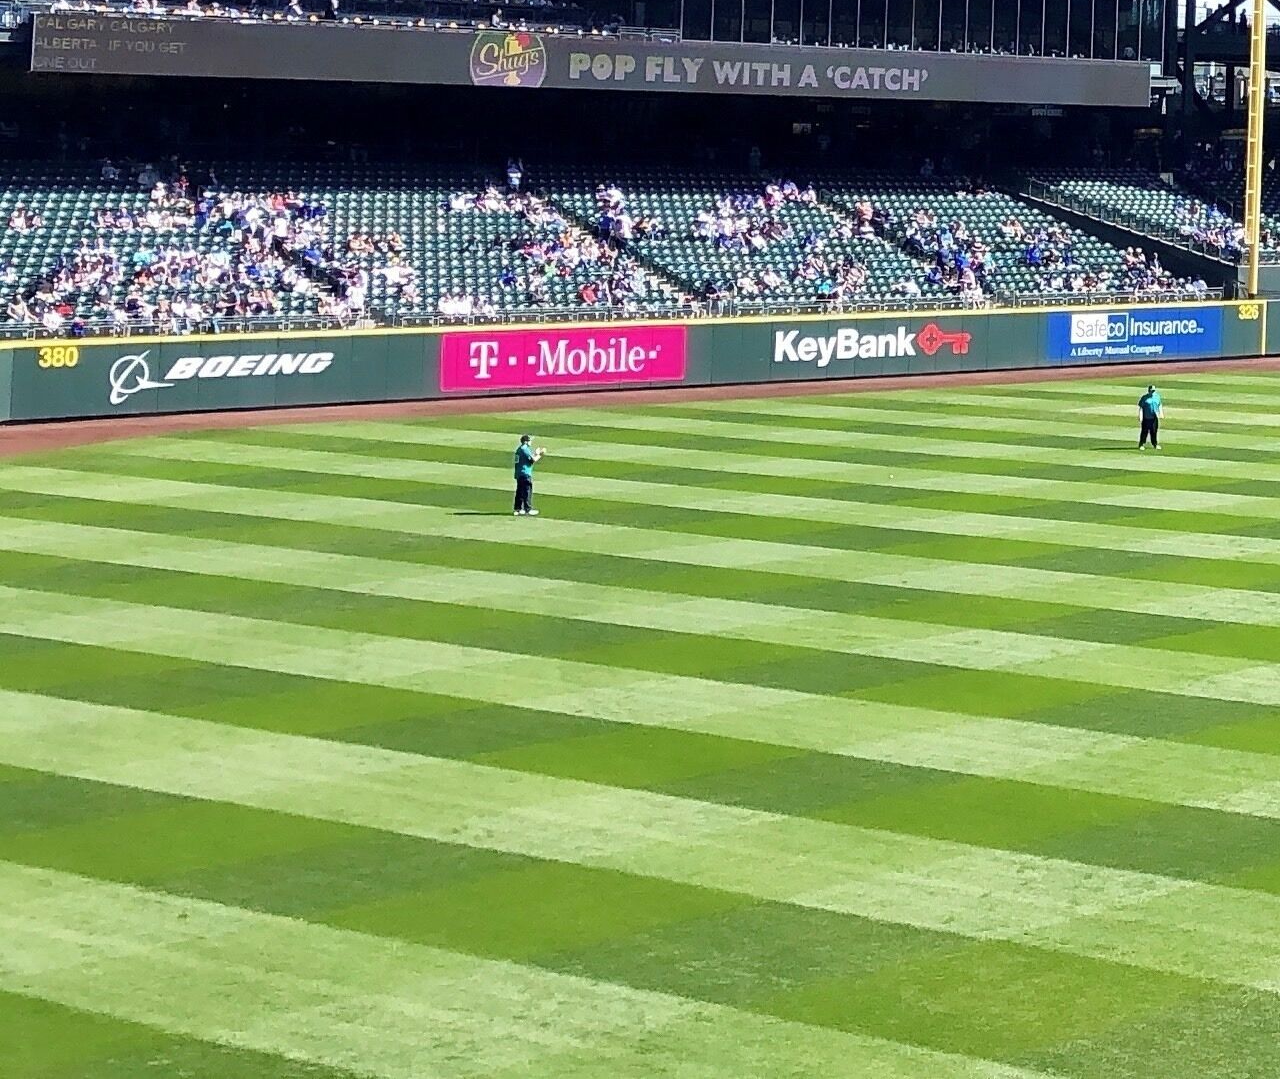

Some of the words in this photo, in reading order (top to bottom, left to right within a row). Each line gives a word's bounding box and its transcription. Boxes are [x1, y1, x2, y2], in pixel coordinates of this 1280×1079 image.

[126, 40, 155, 53] YOU
[67, 58, 96, 70] OUT
[569, 52, 636, 81] POP
[645, 56, 704, 83] FLY
[713, 60, 791, 86] WITH
[798, 64, 819, 88] A
[1238, 304, 1260, 320] 326
[1075, 319, 1125, 338] Safeco
[1130, 317, 1197, 336] Insurance
[38, 346, 80, 368] 380
[774, 326, 916, 368] KeyBank
[1070, 349, 1077, 357] A
[1078, 347, 1103, 357] Liberty
[1131, 344, 1164, 356] Company
[164, 352, 334, 380] BOEING
